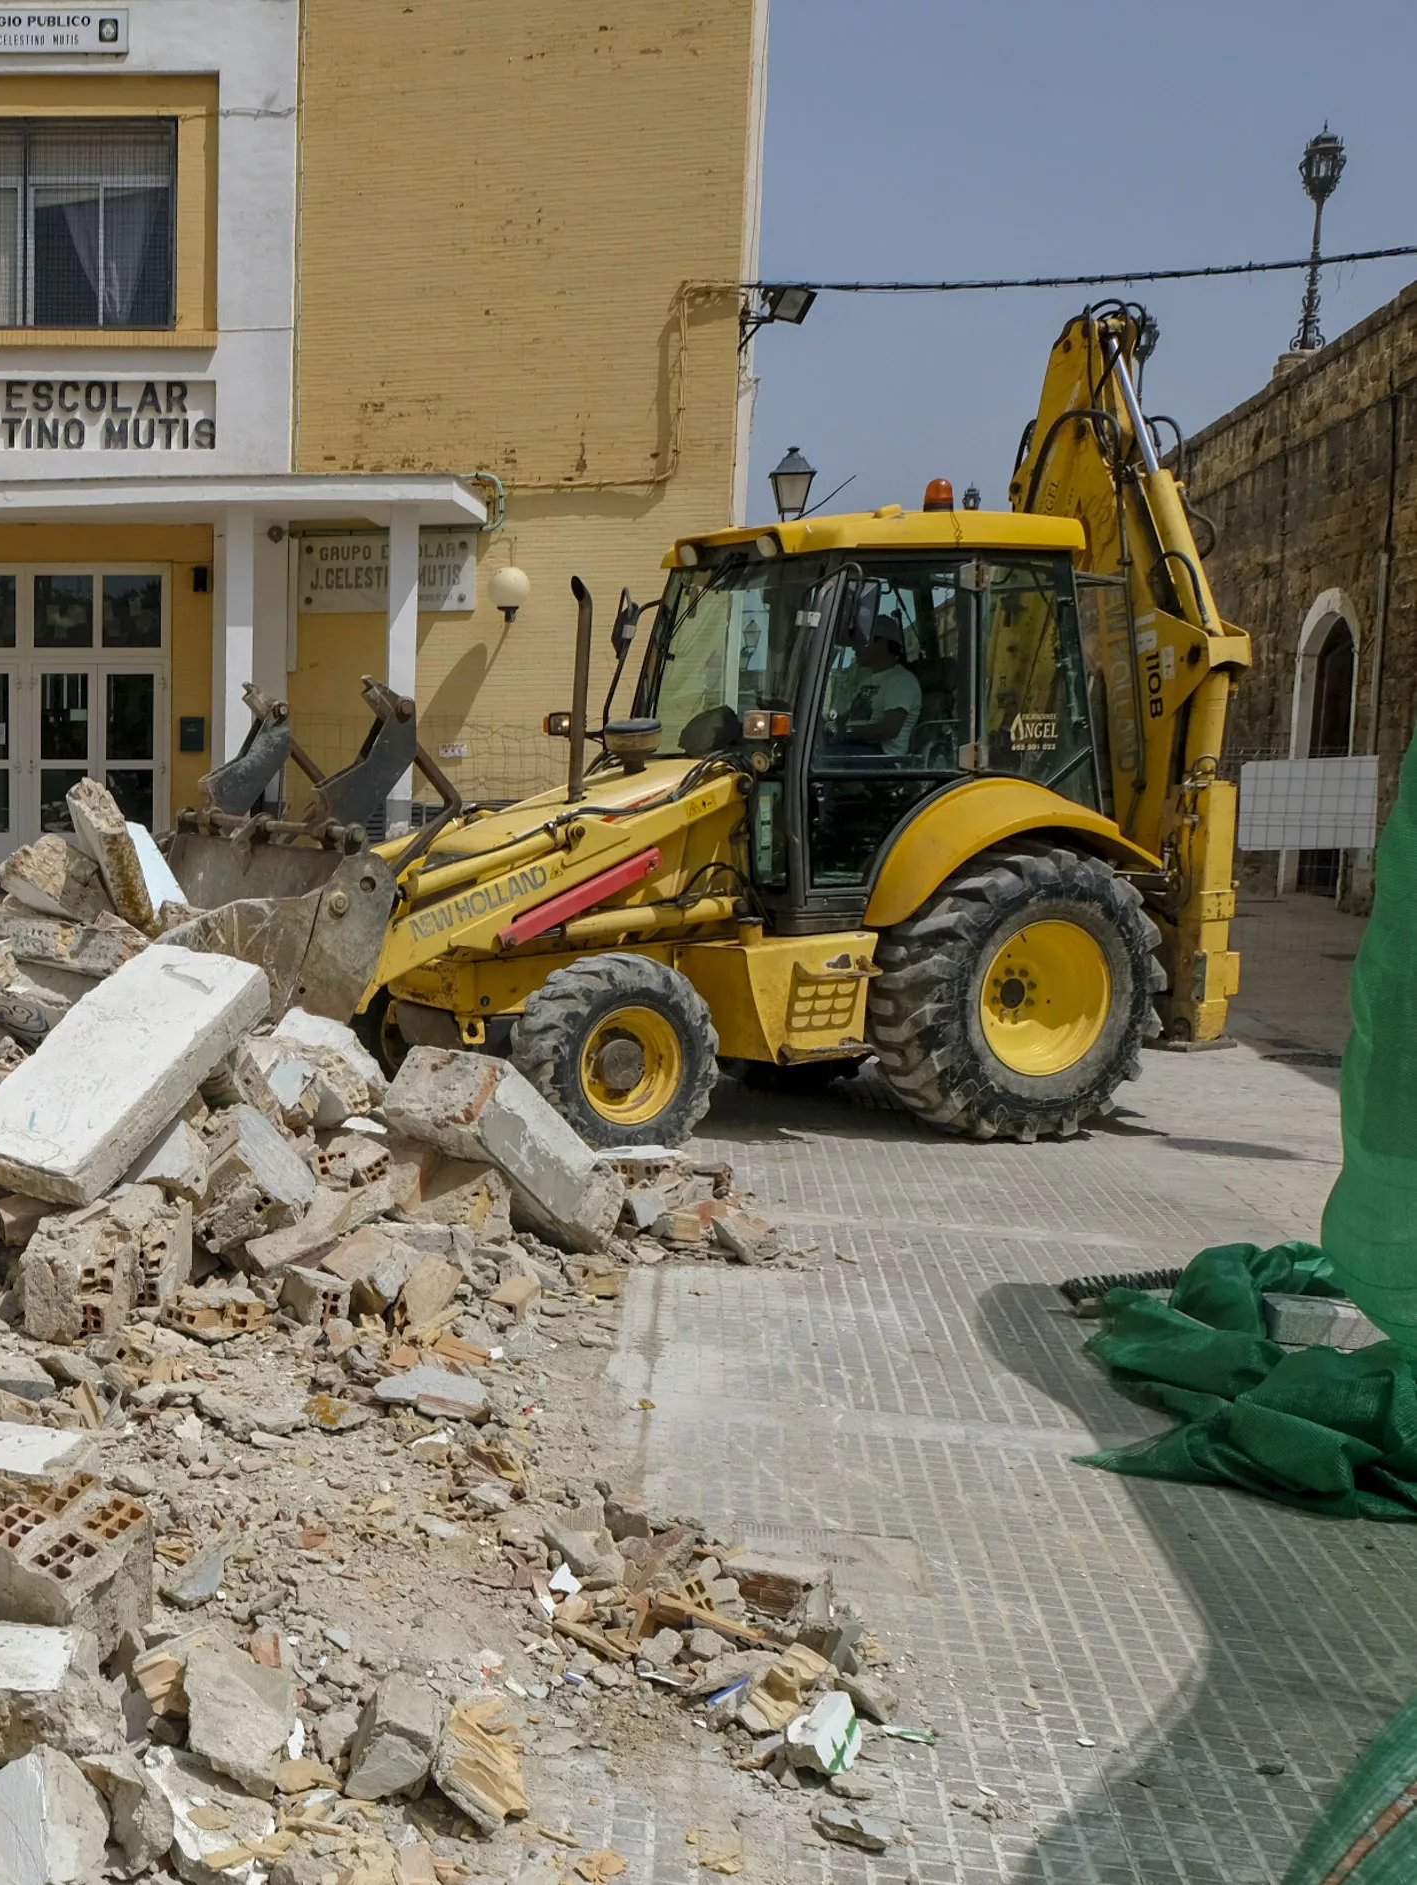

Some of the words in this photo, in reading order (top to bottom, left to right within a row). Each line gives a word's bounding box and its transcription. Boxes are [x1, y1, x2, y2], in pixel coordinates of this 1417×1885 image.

[27, 15, 91, 27] PUBLICO
[53, 34, 80, 46] MUTIS
[5, 380, 188, 412] ESCOLAR
[104, 418, 216, 450] MUTIS
[319, 545, 371, 561] GRUPO
[1010, 712, 1059, 742] ANGEL
[408, 909, 454, 943] NEW
[456, 864, 548, 923] HOLLAND
